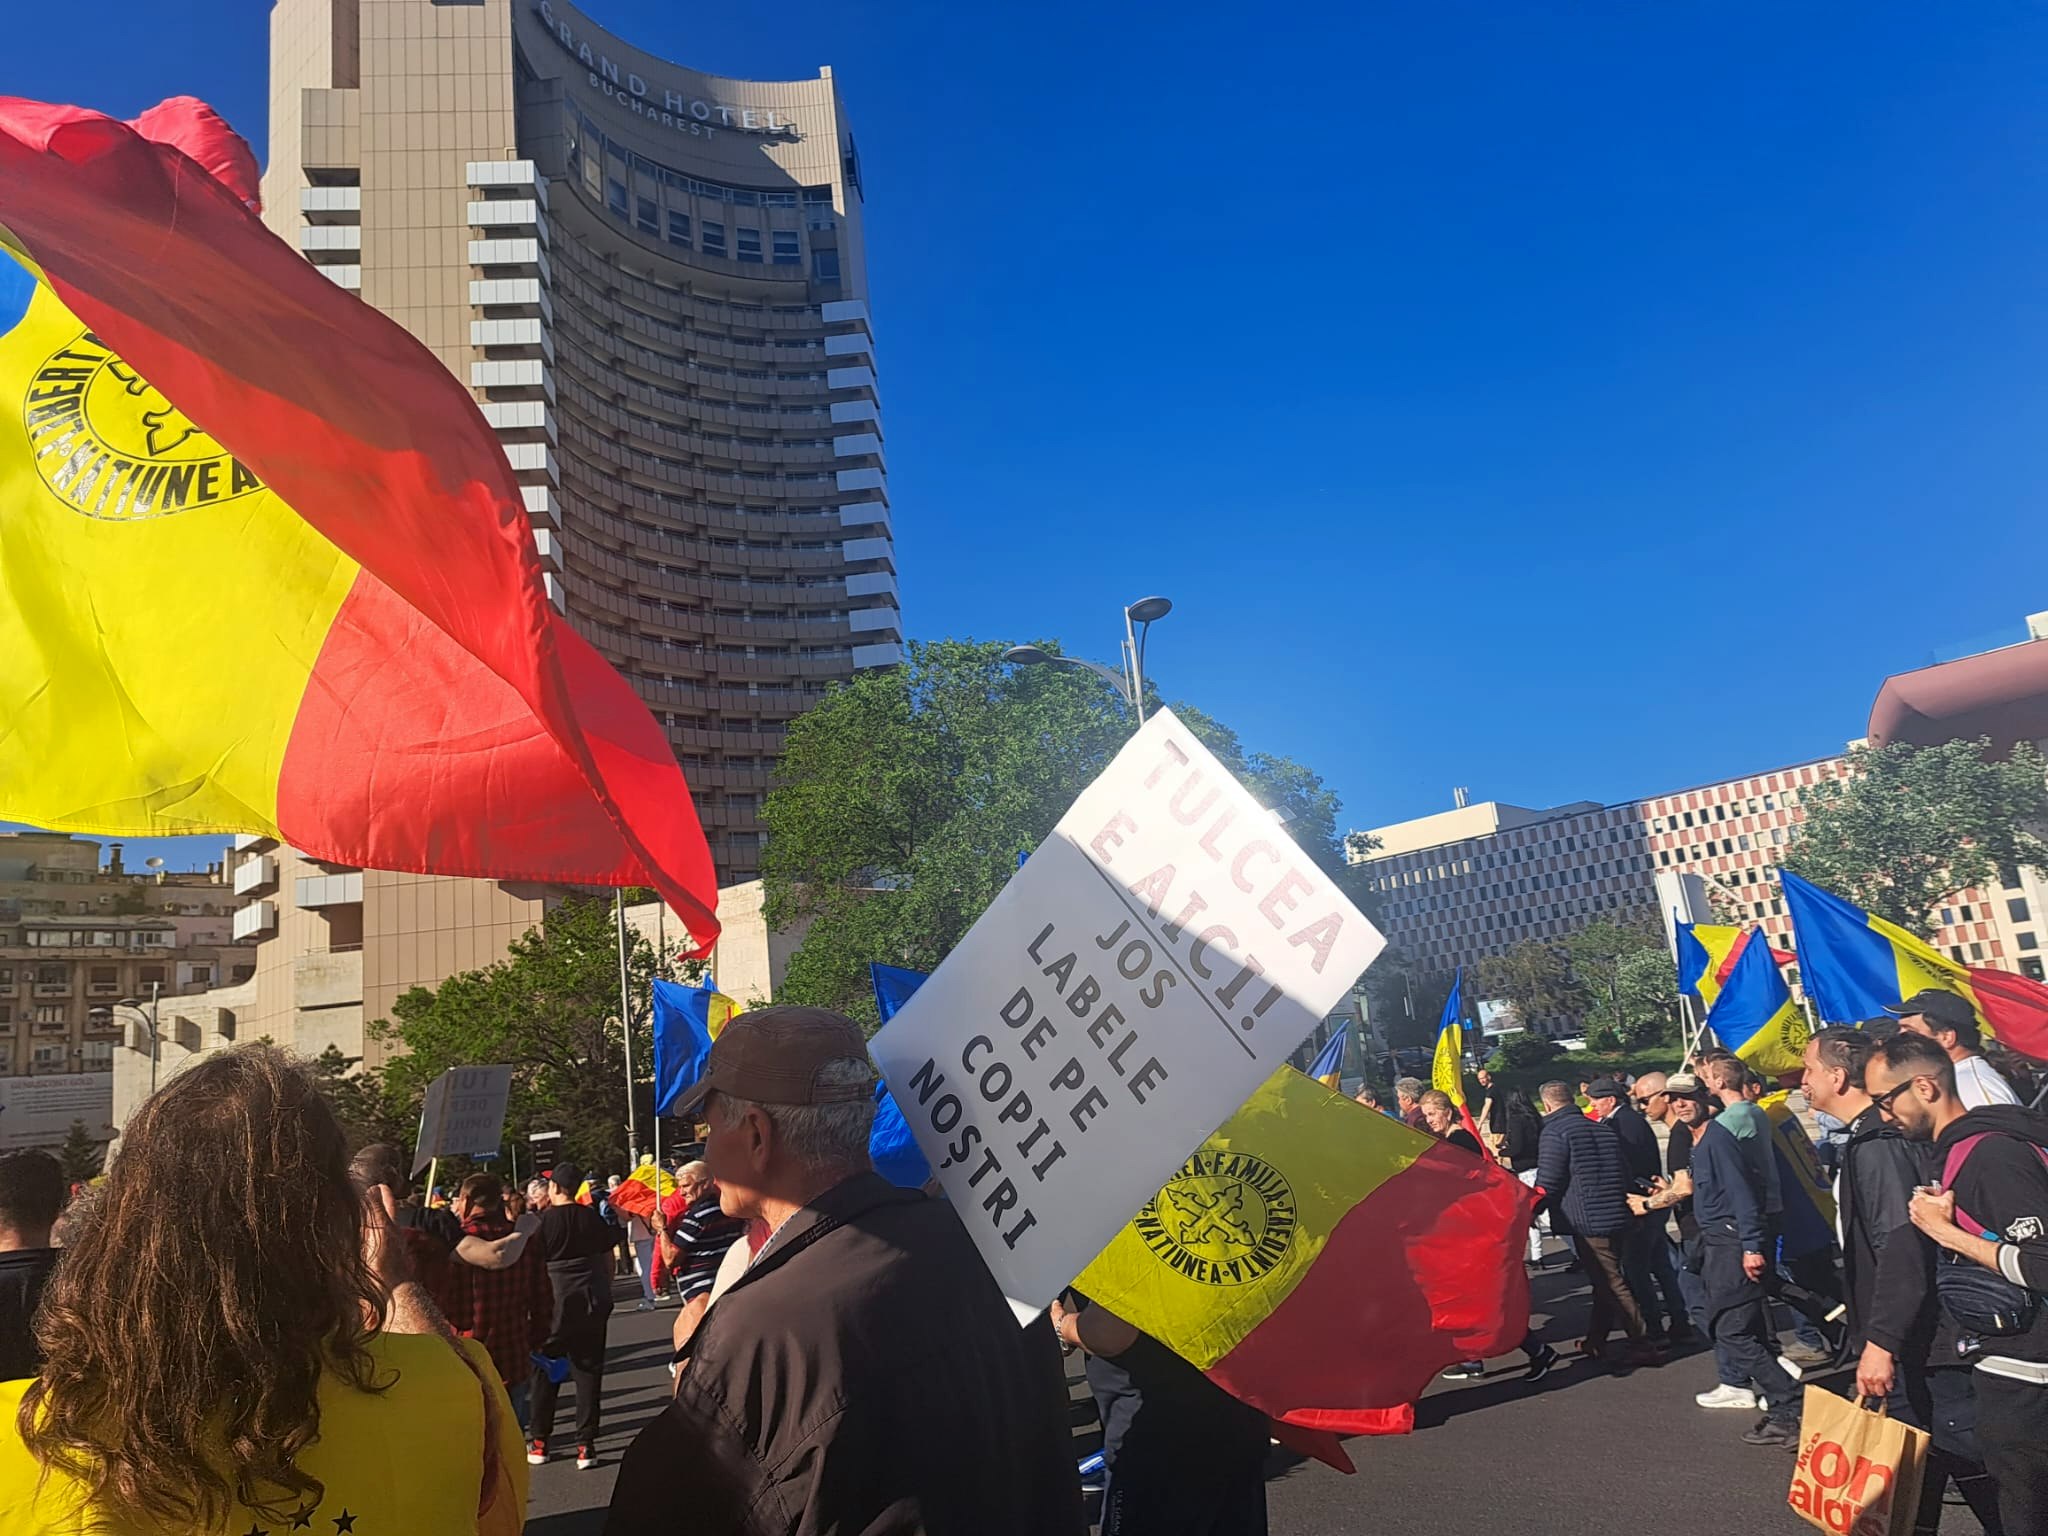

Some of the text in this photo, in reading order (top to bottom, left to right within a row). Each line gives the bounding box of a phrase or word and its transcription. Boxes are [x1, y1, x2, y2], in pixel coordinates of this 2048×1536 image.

[540, 1, 785, 130] GRAND HOTEL
[589, 72, 717, 140] BUCHAREST
[1090, 809, 1138, 865] E
[1128, 863, 1284, 1031] AICI!
[1143, 738, 1344, 975] TULCEA
[1026, 922, 1169, 1105] LABELE
[1095, 919, 1177, 1008] JOS
[962, 1034, 1067, 1182] COPII
[1000, 986, 1109, 1133] DE PE
[908, 1057, 1038, 1250] NOȘTRI
[1213, 1152, 1289, 1203] FAMILIA
[1810, 1441, 1893, 1515] on
